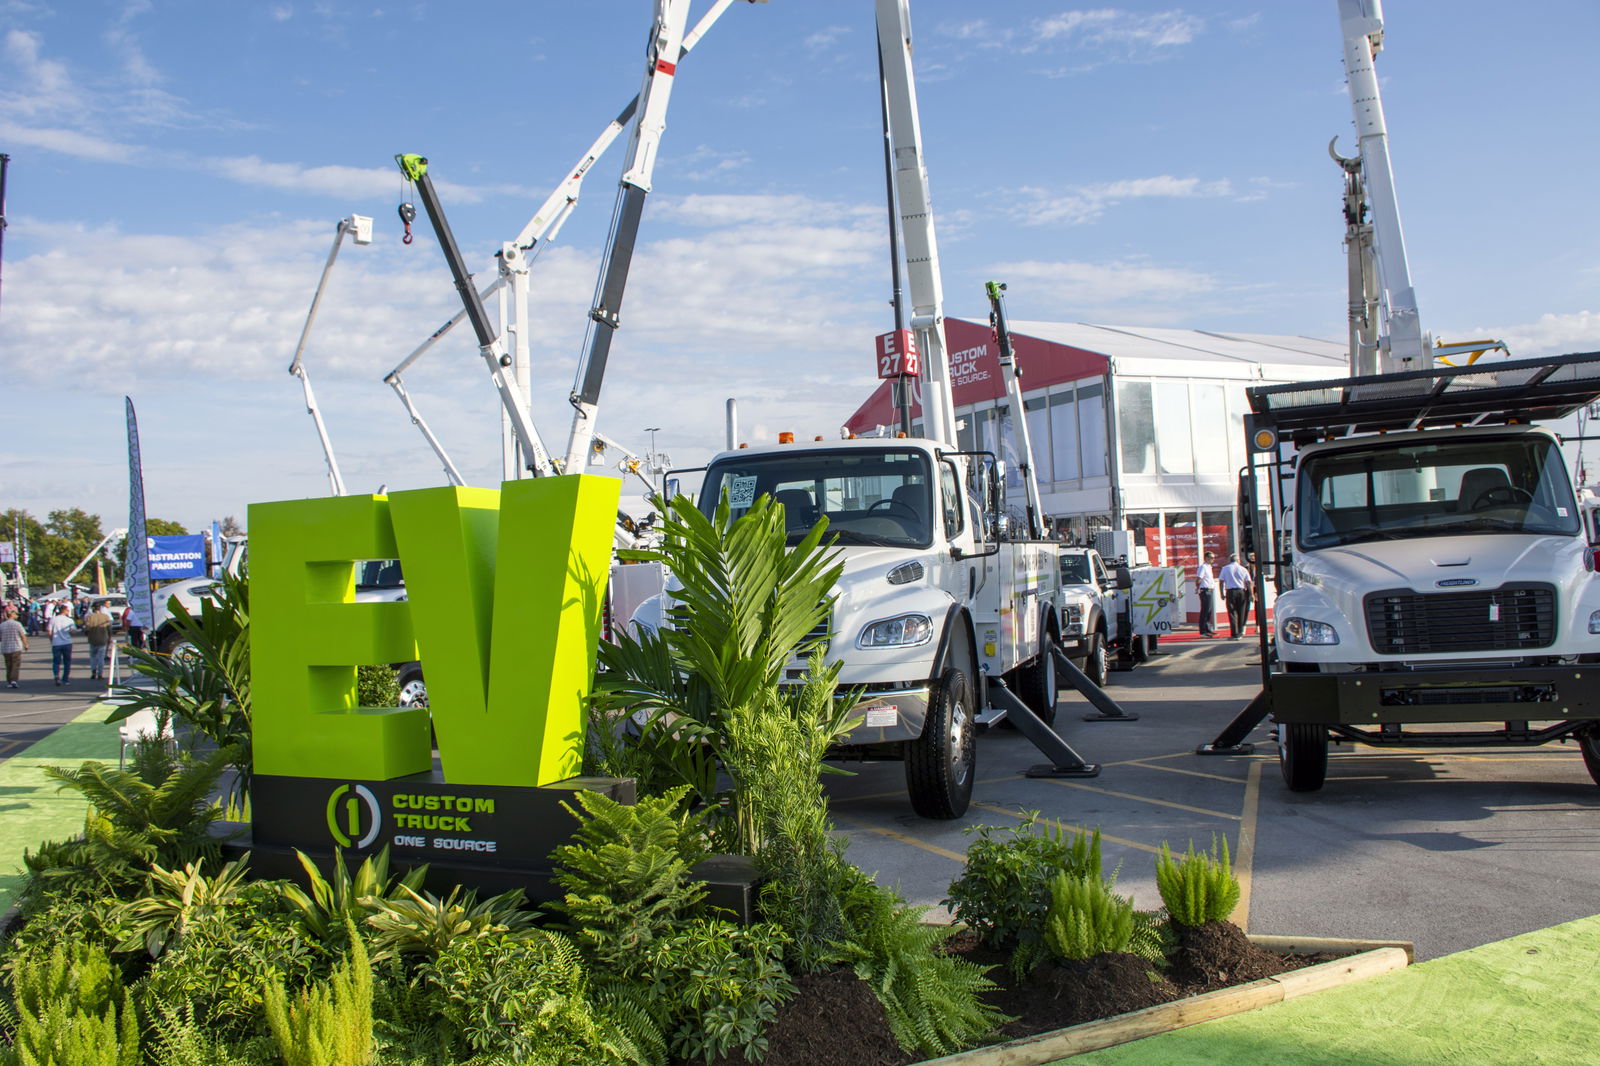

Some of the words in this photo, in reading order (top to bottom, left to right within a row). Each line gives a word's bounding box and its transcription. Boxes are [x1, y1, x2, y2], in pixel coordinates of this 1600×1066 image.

[883, 333, 896, 354] E
[907, 332, 916, 353] E
[880, 353, 901, 376] 27
[906, 352, 918, 374] 27
[948, 344, 987, 366] USTOM
[949, 360, 977, 377] RUCK
[148, 552, 202, 561] ISTRATION
[151, 561, 194, 570] PARKING
[248, 474, 621, 787] EV
[392, 794, 495, 814] CUSTOM
[393, 813, 472, 832] TRUCK
[393, 835, 426, 848] ONE
[433, 837, 497, 852] SOURCE
